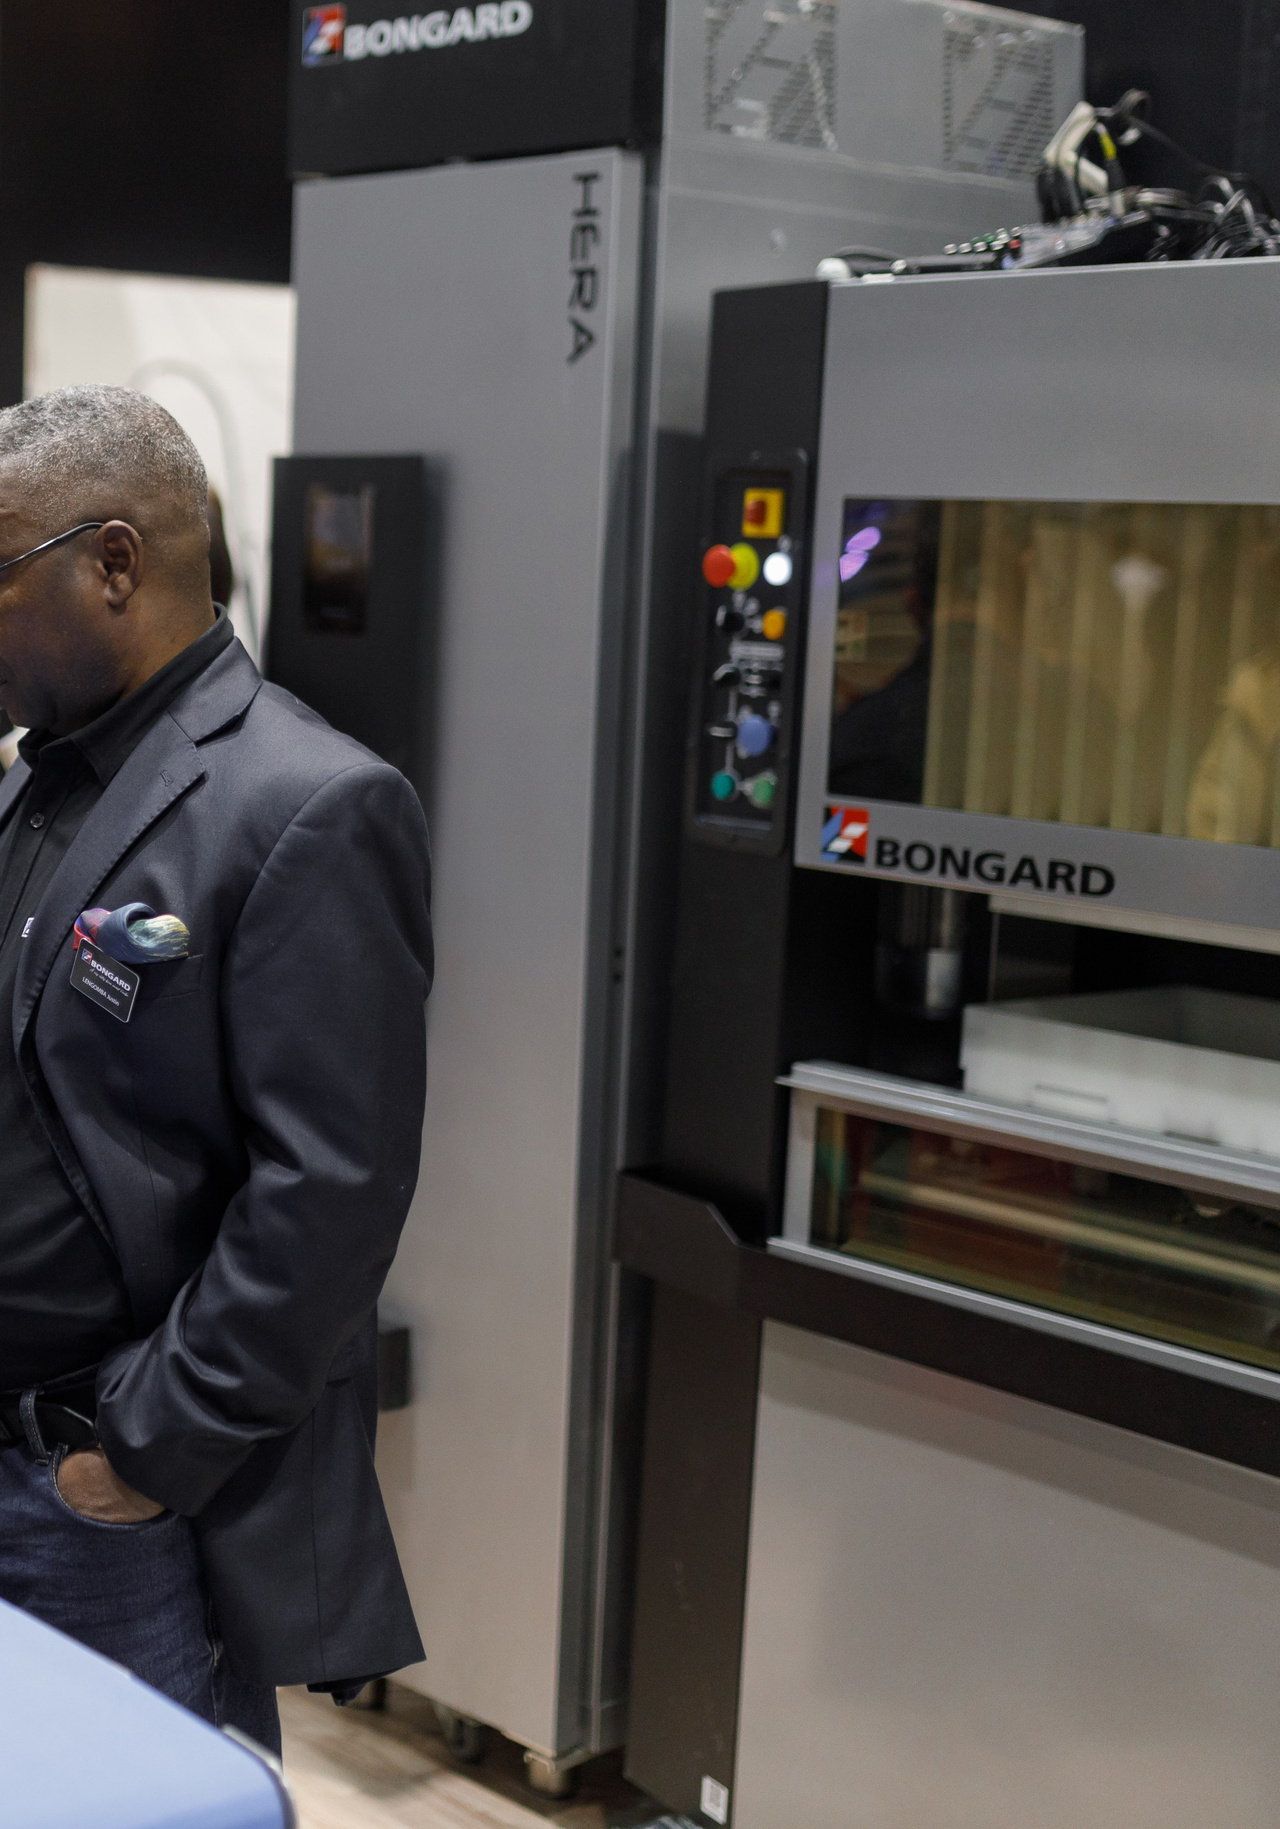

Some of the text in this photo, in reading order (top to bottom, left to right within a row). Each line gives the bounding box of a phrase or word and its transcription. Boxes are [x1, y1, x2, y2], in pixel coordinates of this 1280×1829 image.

[343, 0, 533, 61] BONGARD
[567, 172, 601, 366] HERA
[874, 836, 1116, 897] BONGARD
[90, 960, 131, 991] BONGARD
